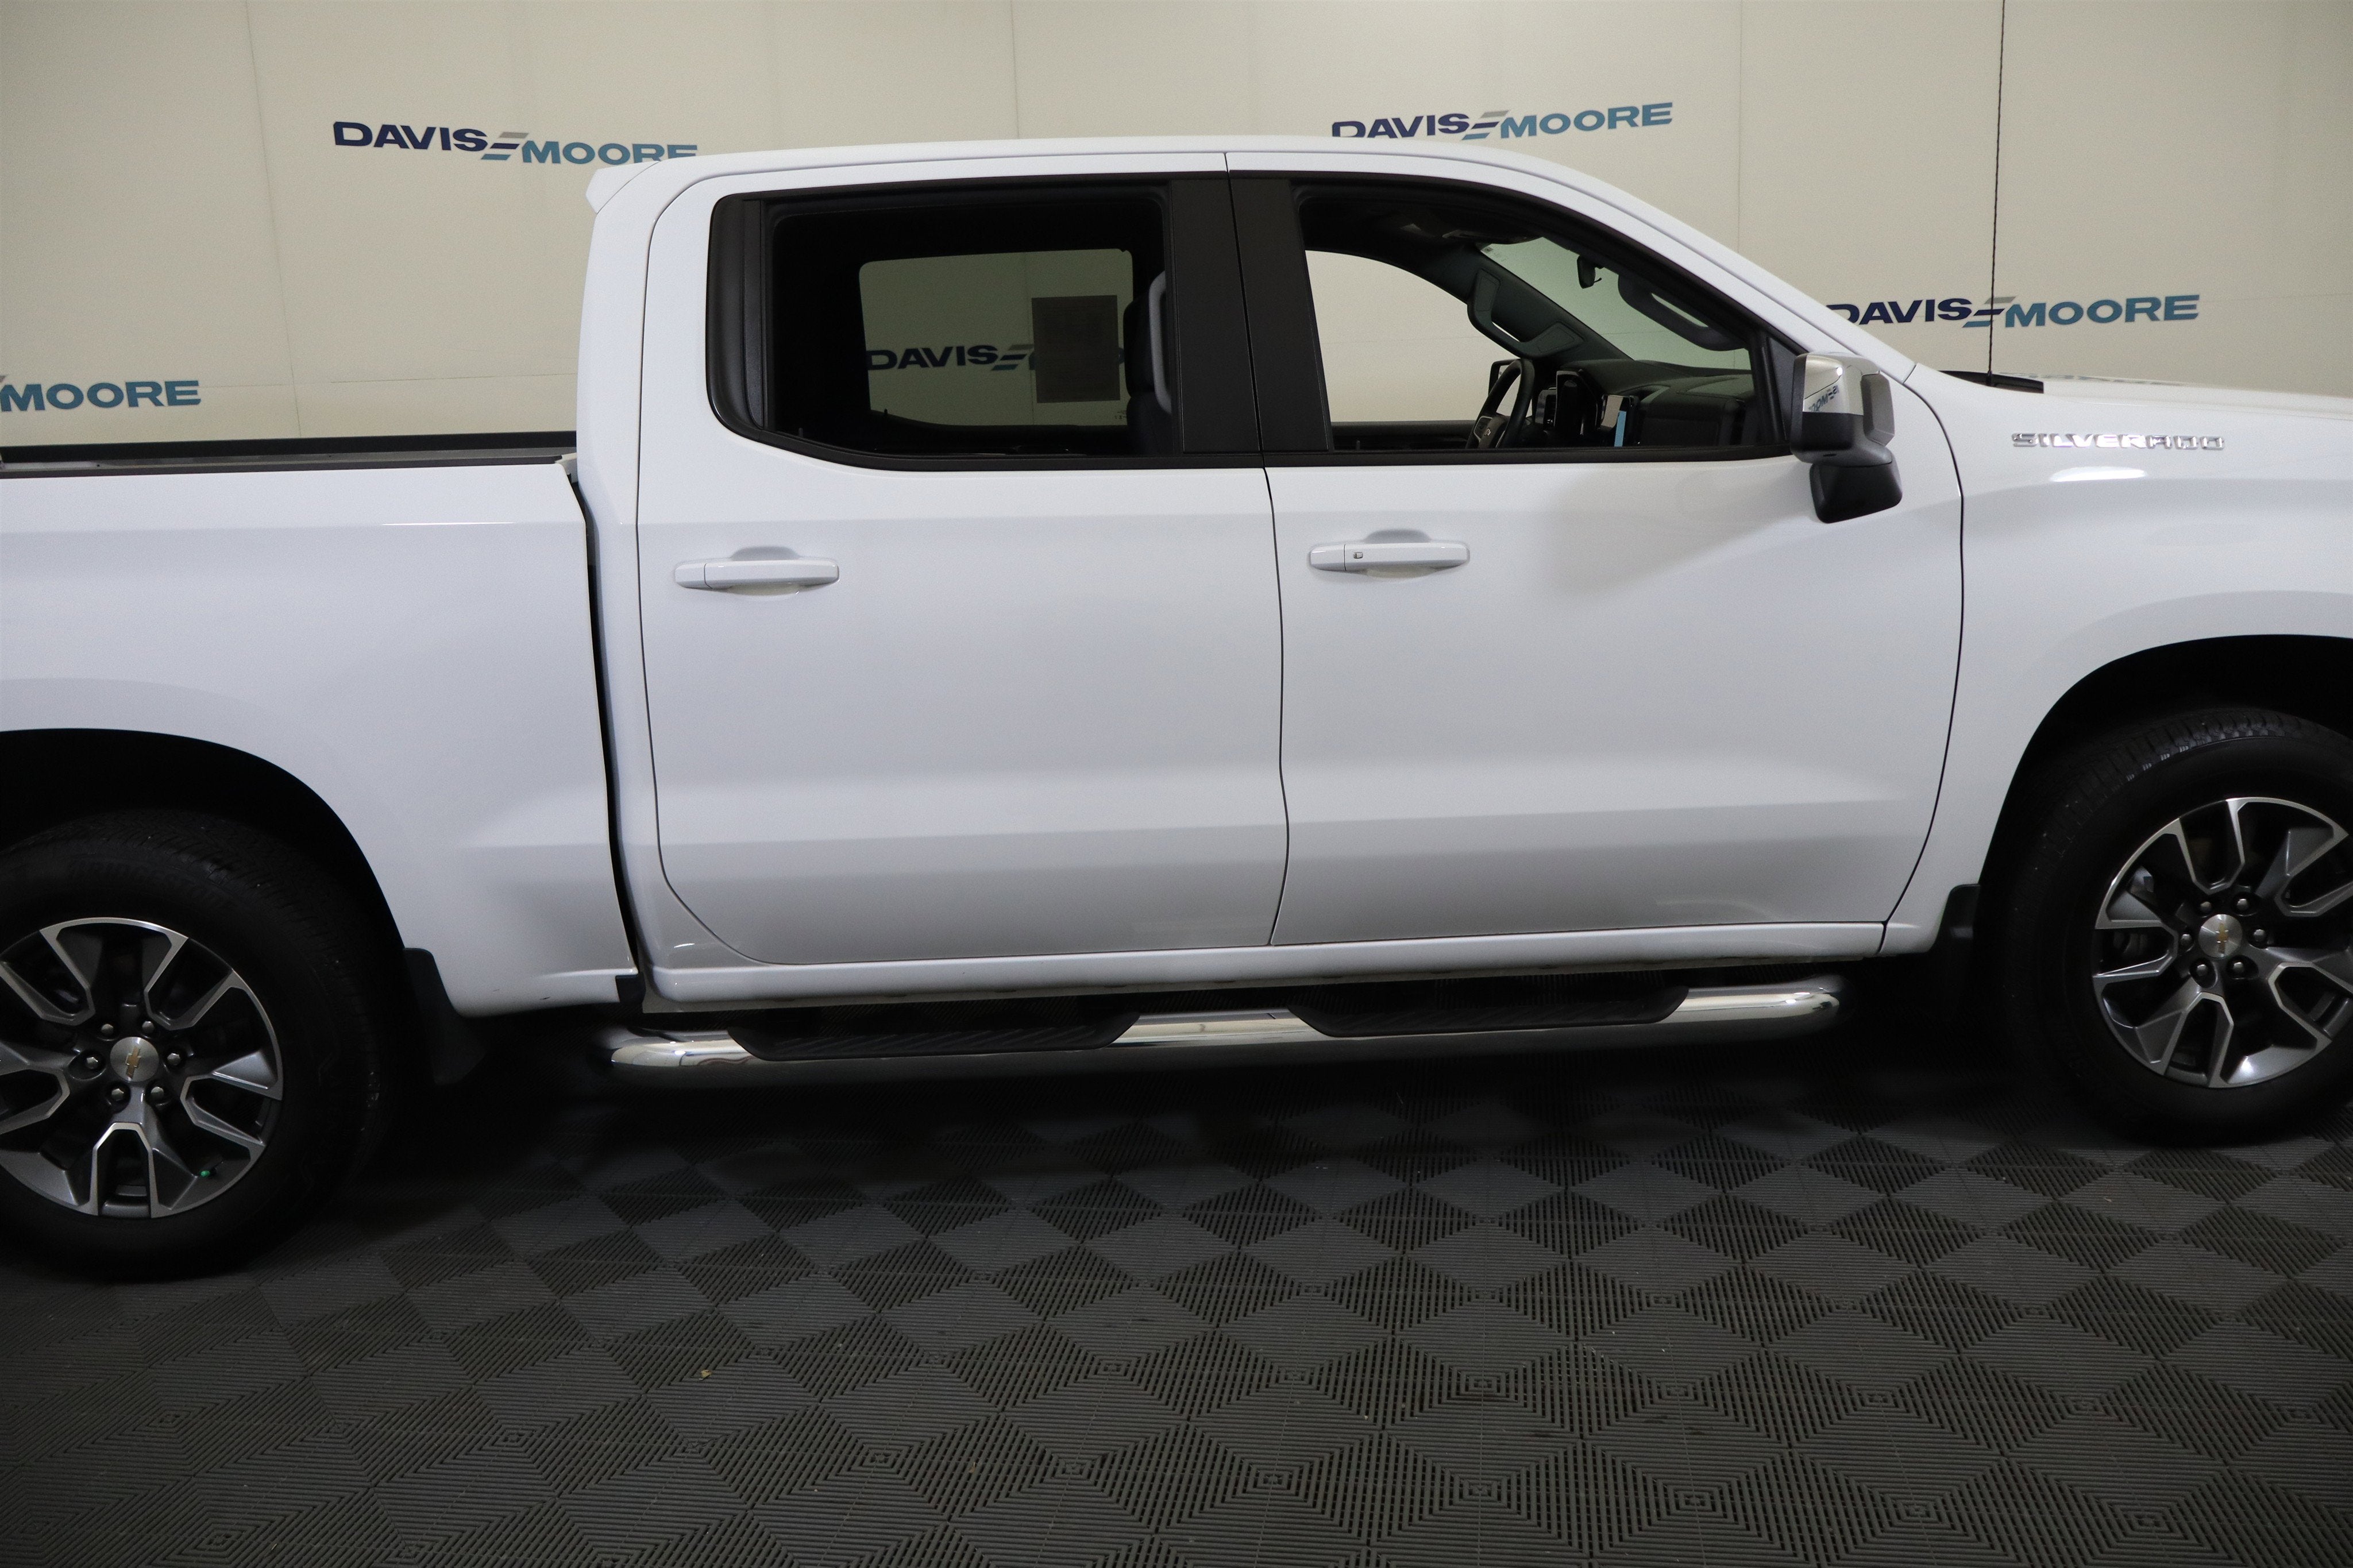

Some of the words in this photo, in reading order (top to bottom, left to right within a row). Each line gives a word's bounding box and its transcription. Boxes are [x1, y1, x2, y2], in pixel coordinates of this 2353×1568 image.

[1332, 113, 1471, 138] DAVIS
[1500, 102, 1673, 139] MOORE
[333, 121, 488, 152] DAVIS
[2005, 294, 2200, 328] MOORE
[866, 345, 998, 370] DAVIS
[0, 380, 201, 412] MOORE
[2012, 433, 2225, 450] SILVERADO
